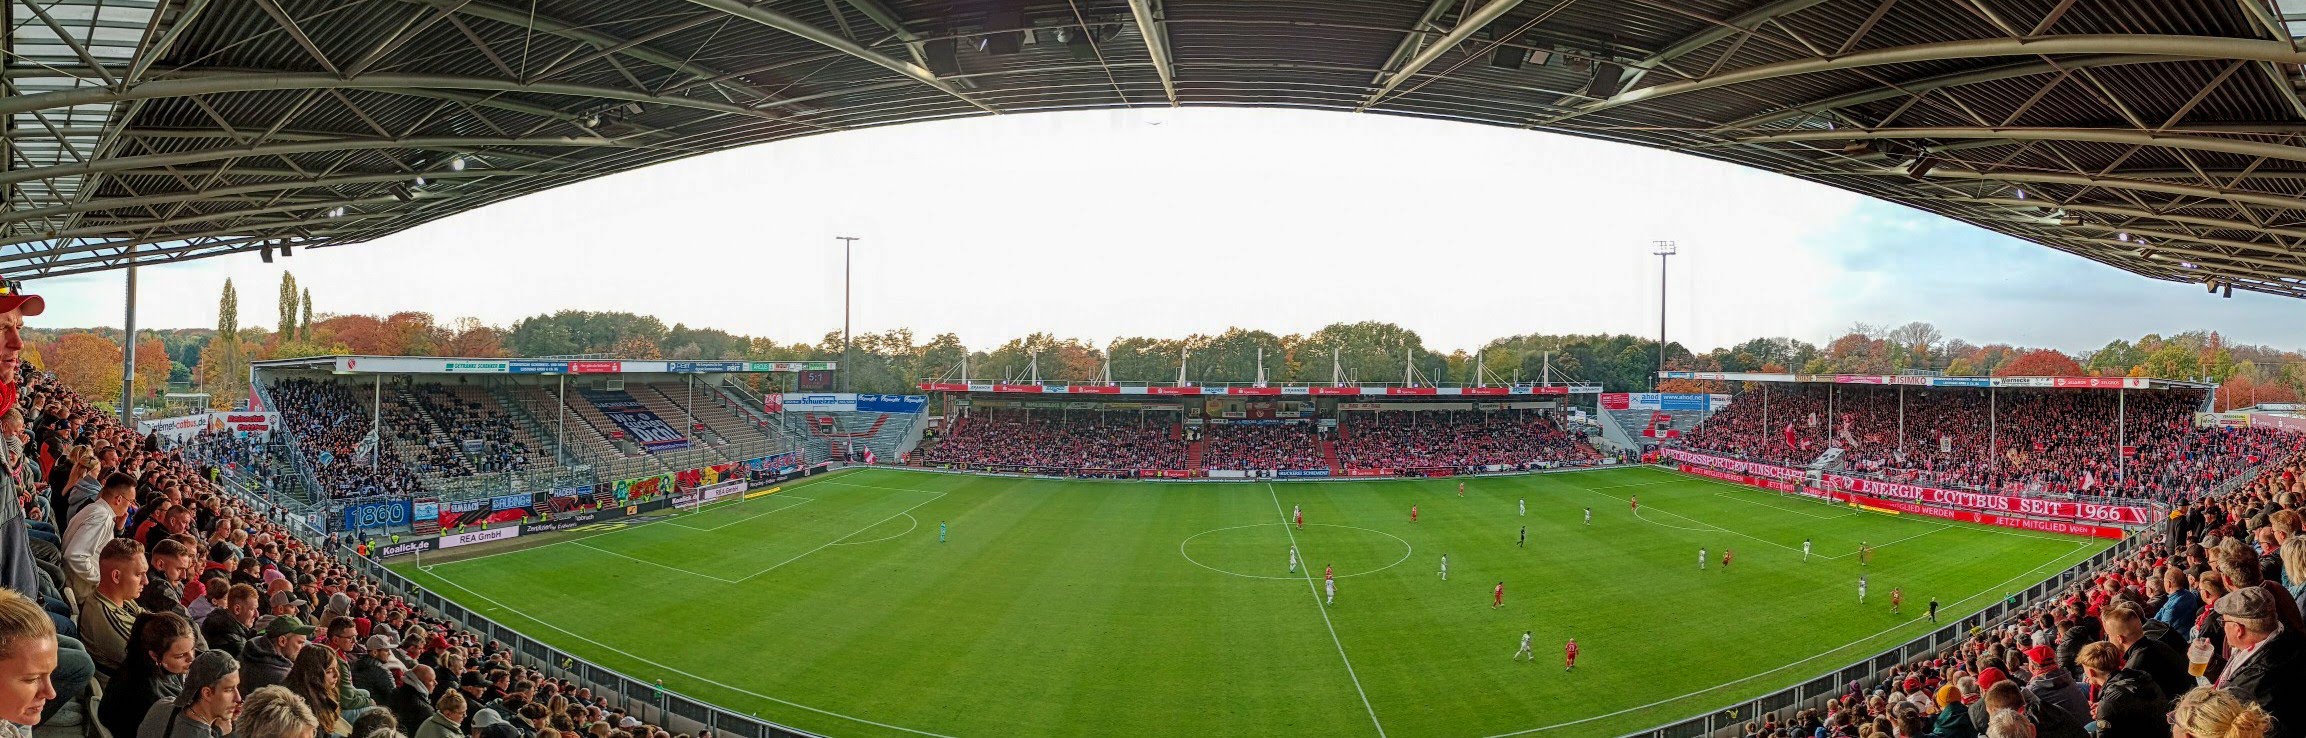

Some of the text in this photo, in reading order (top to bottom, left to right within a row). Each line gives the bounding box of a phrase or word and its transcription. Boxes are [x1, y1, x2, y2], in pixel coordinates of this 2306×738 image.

[809, 373, 822, 382] 5:1
[1863, 481, 2120, 520] ENERGIE COTTBUS SEIT 1966
[352, 503, 404, 527] 1860
[1922, 506, 1954, 517] WERDEN
[1995, 516, 2020, 526] JETZT
[2022, 520, 2067, 532] MITGLIED
[460, 530, 501, 544] REA GmbH
[383, 541, 430, 555] Koalick.de
